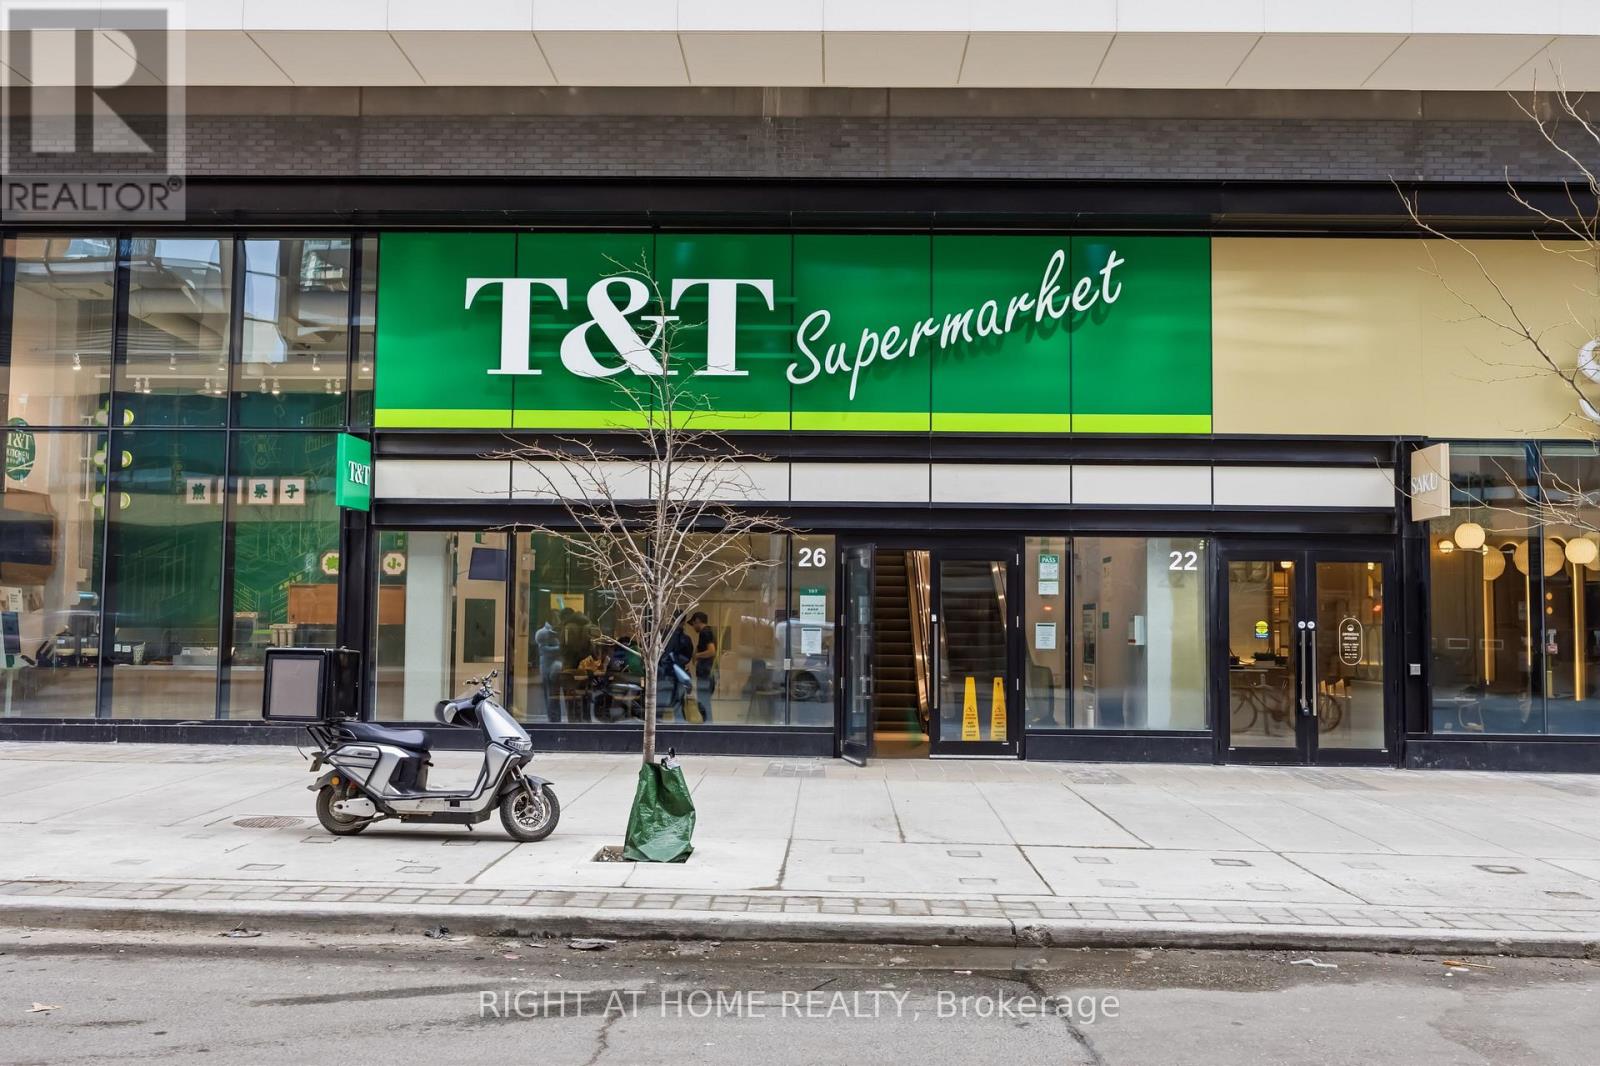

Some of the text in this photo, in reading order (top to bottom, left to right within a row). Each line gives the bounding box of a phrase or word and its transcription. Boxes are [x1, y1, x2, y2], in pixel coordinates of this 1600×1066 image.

[464, 249, 1125, 401] T&T Supermarket
[348, 460, 371, 486] T&T
[1411, 472, 1438, 495] SAKU
[798, 547, 827, 568] 26
[1169, 550, 1198, 571] 22
